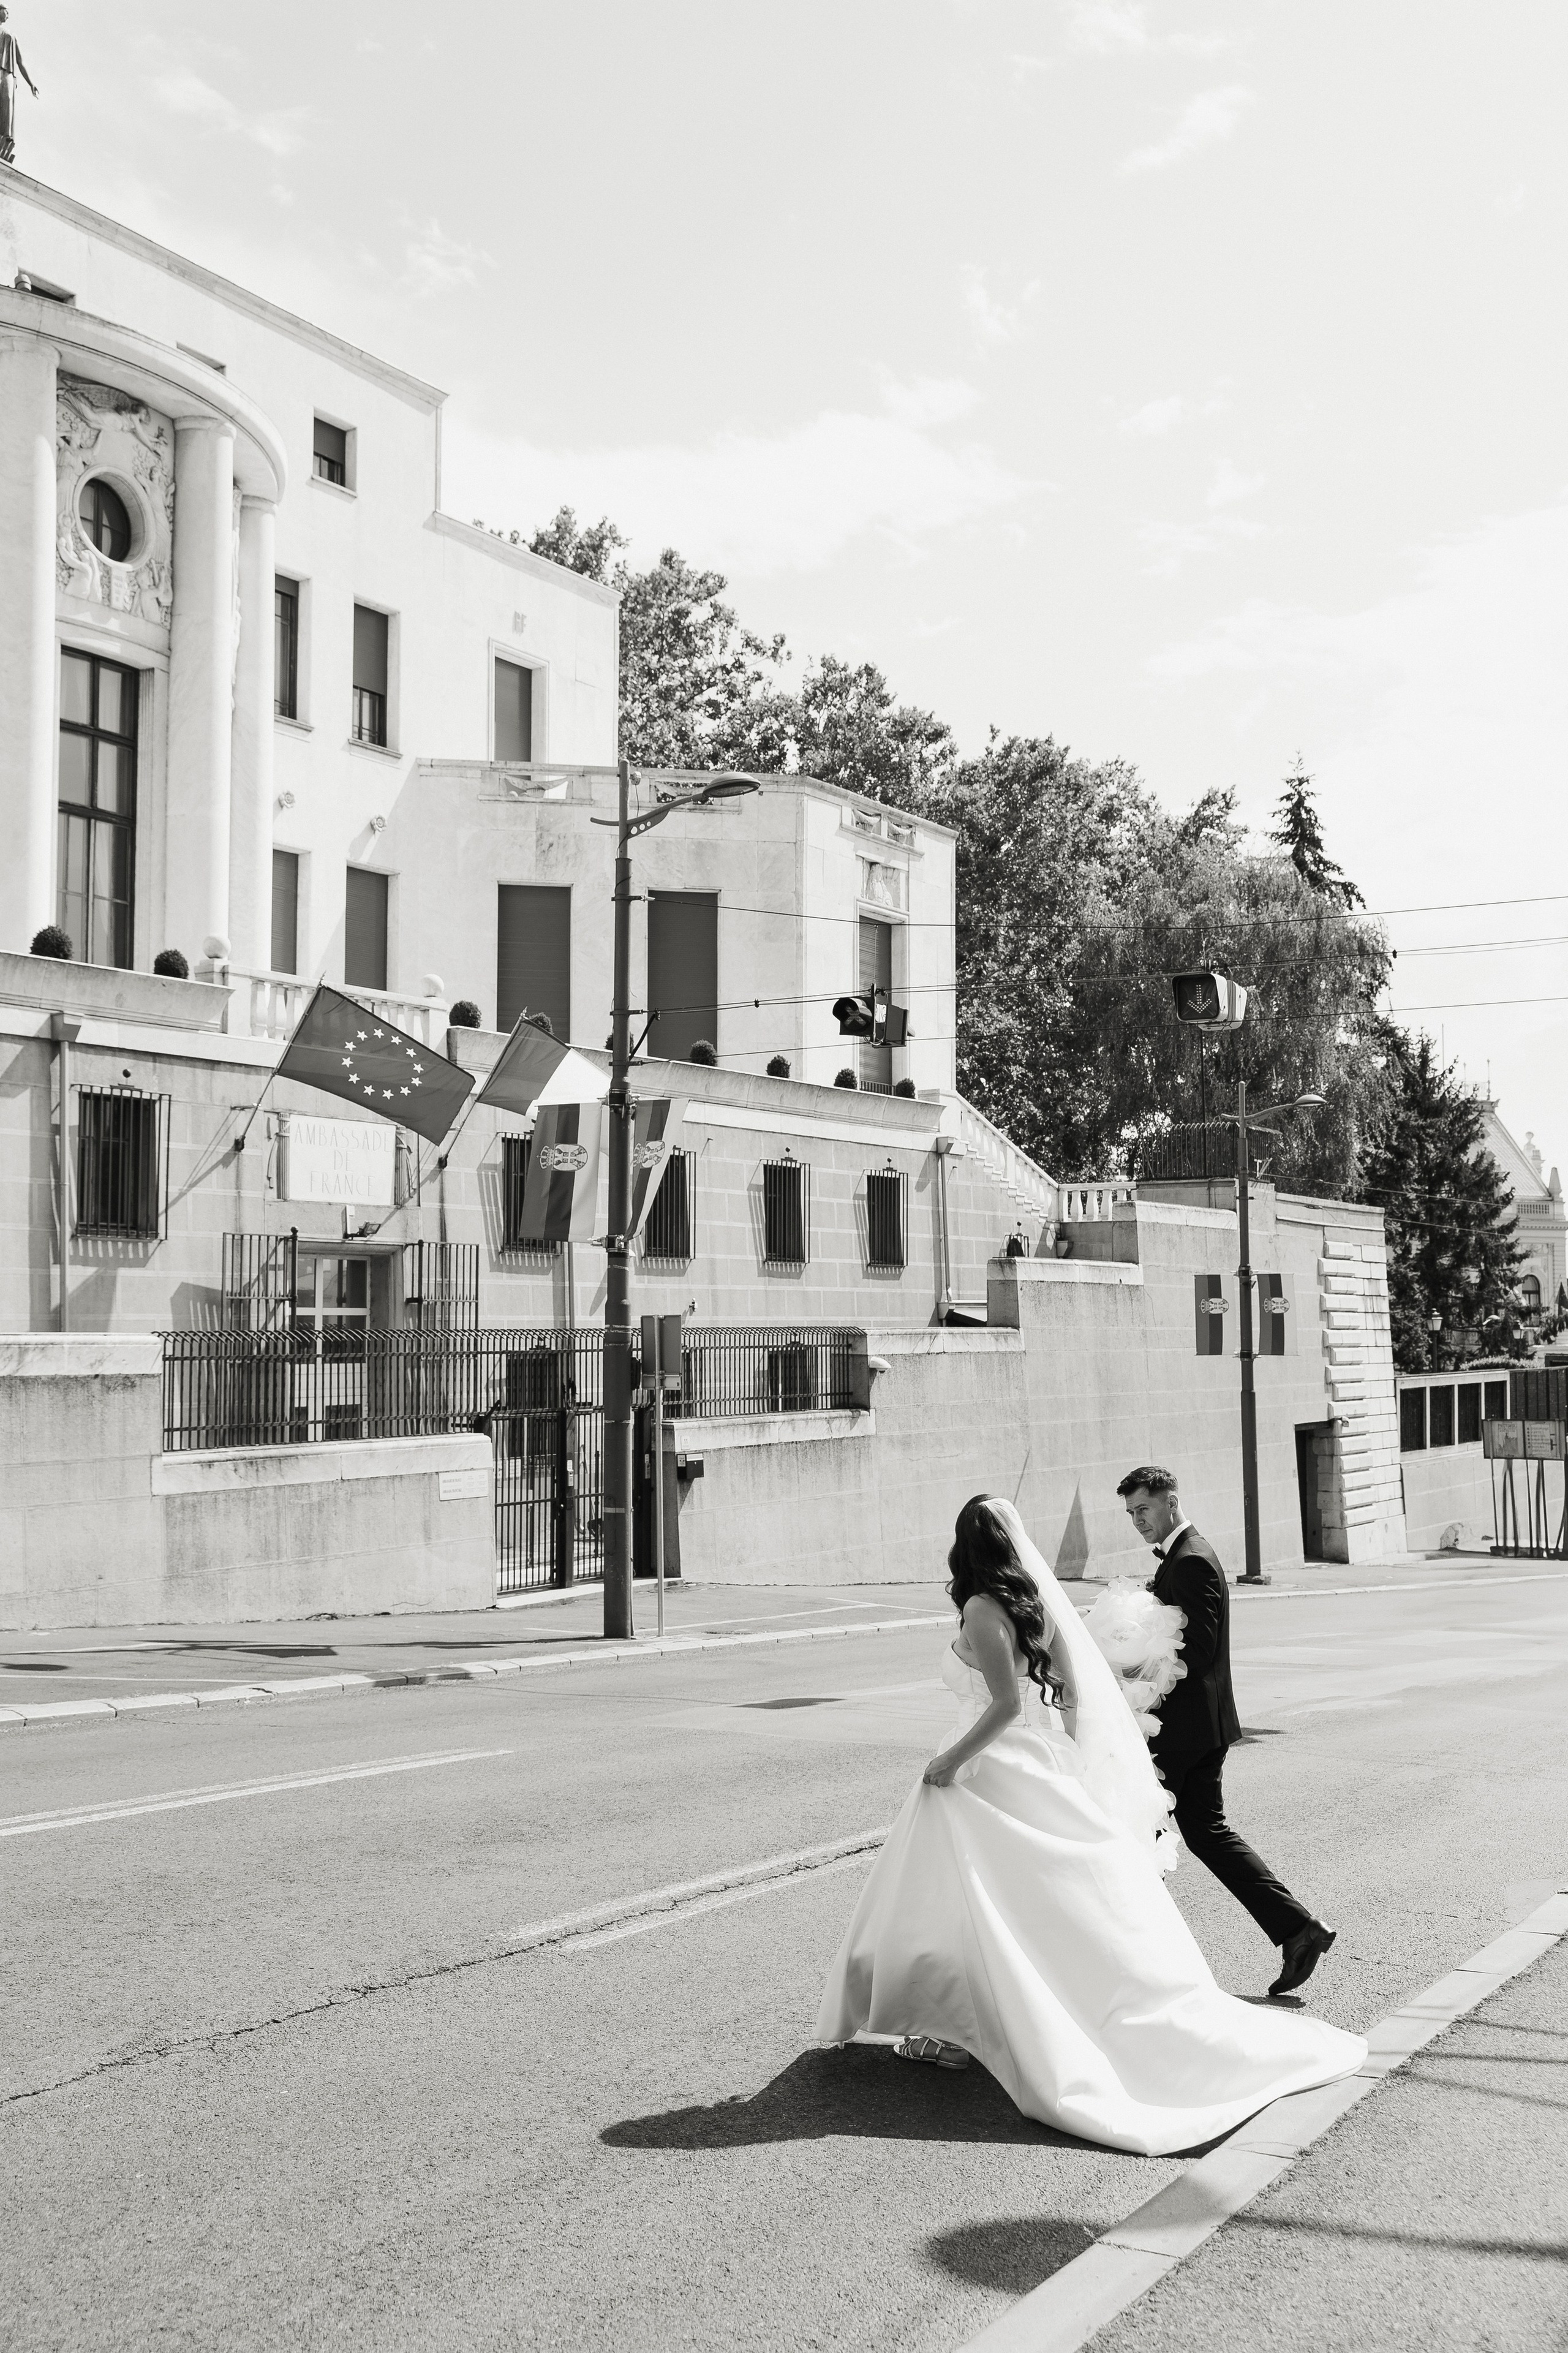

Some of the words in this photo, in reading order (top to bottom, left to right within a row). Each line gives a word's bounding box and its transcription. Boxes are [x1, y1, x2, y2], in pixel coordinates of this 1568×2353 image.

[295, 1123, 392, 1153] AMBASSADE
[334, 1150, 353, 1173] DE
[310, 1171, 376, 1197] FRANCE
